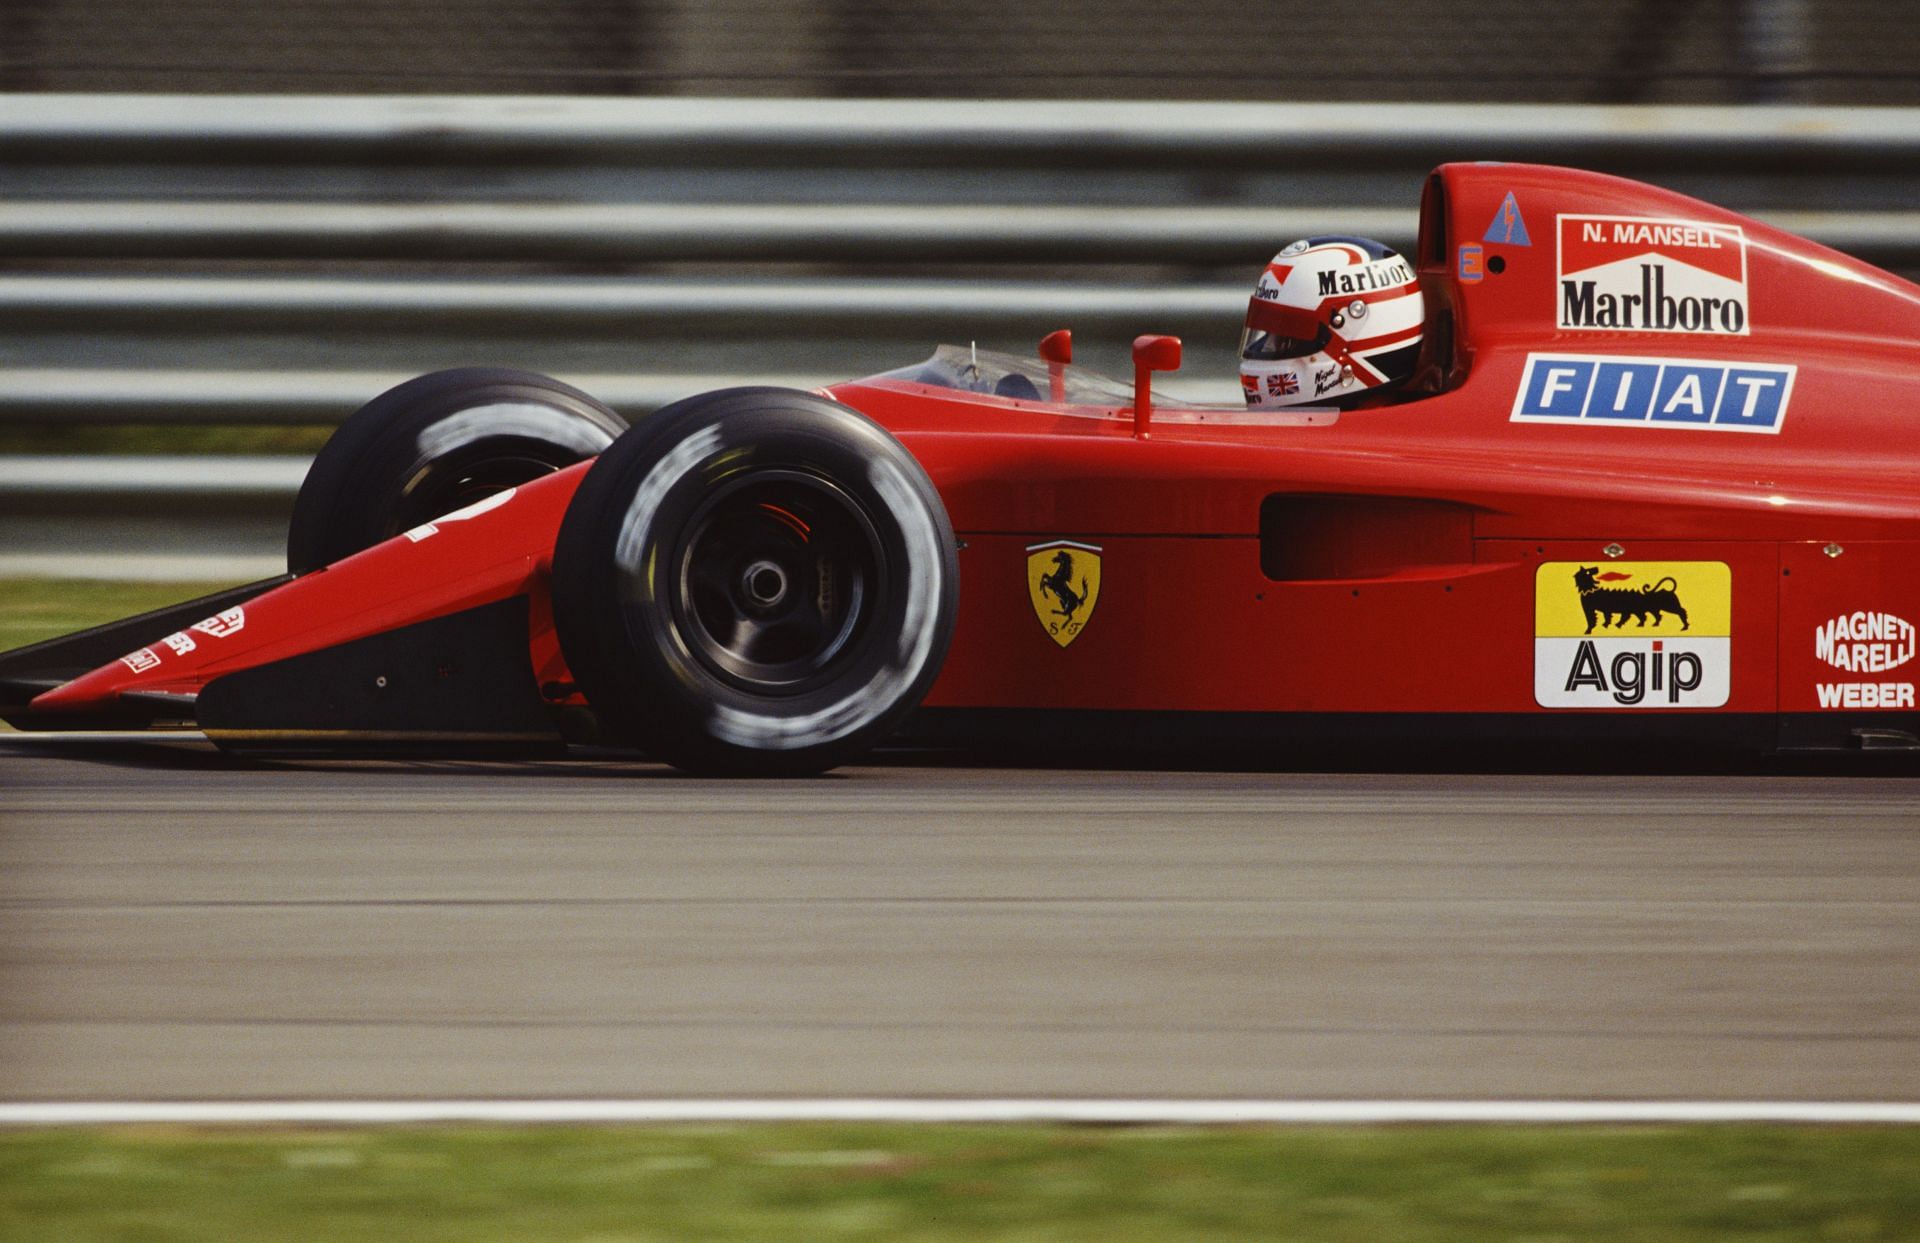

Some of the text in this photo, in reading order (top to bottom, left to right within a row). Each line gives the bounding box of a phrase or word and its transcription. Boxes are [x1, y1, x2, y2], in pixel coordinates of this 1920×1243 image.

[1583, 223, 1721, 248] N. MANSELL
[1460, 246, 1483, 279] E
[1561, 264, 1744, 332] Marlboro
[1539, 369, 1776, 417] FIAT
[1050, 622, 1059, 635] S
[1816, 611, 1916, 652] MAGNETI
[1564, 640, 1702, 704] Agip
[1816, 630, 1916, 673] MARELLI
[1816, 682, 1915, 708] WEBER
